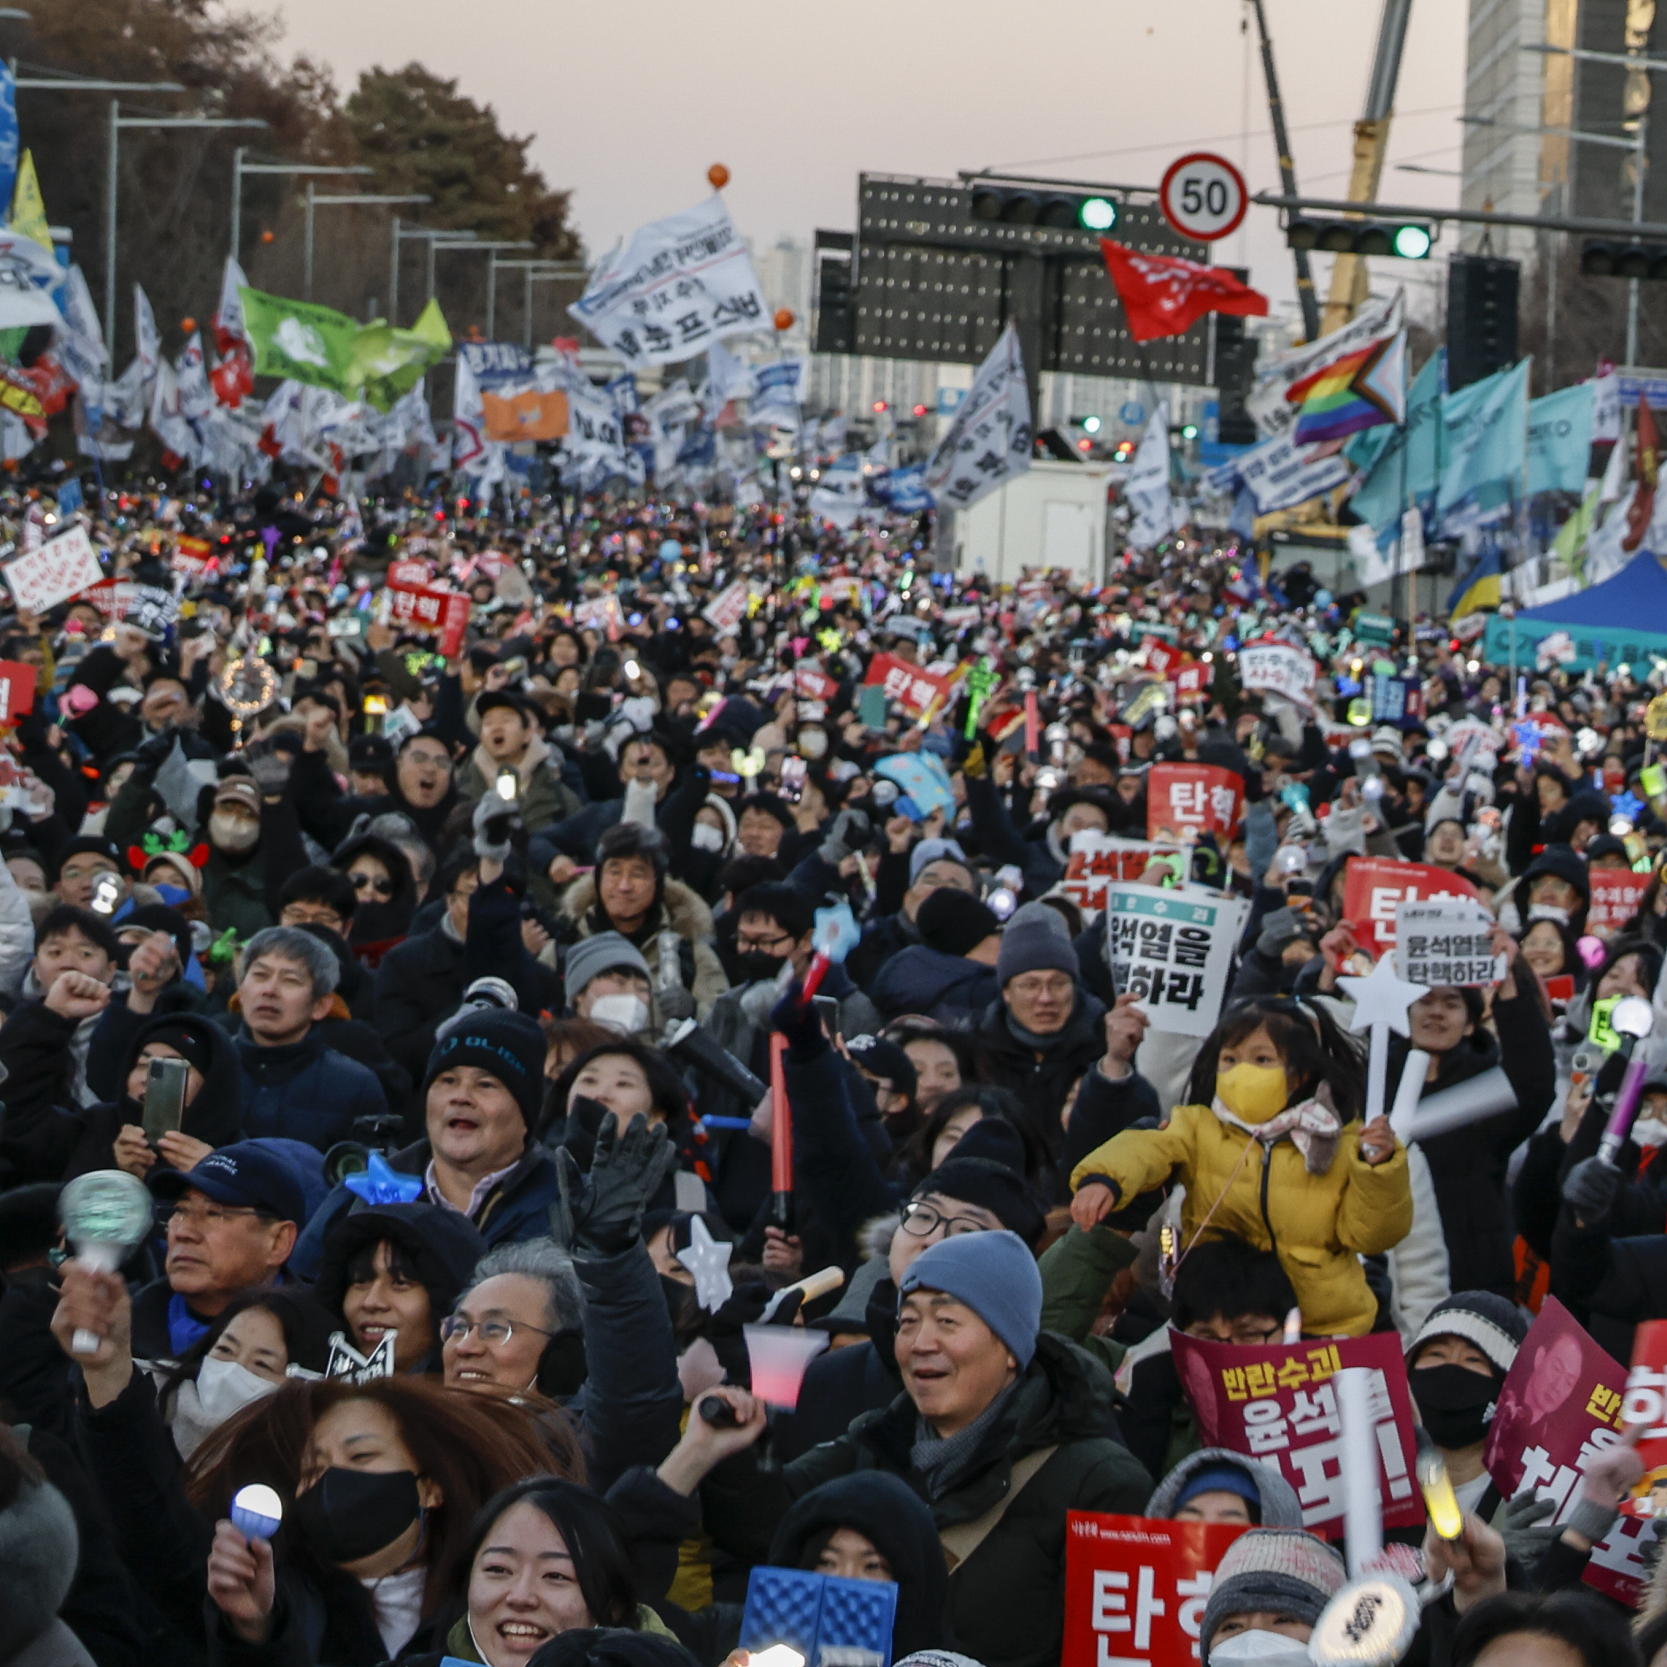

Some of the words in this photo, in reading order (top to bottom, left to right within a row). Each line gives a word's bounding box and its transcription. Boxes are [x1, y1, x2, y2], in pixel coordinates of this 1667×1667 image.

[1181, 178, 1228, 216] 50
[885, 665, 937, 706] 탄핵
[1168, 783, 1235, 836] 탄핵
[1407, 935, 1494, 958] 윤석열을
[1407, 961, 1497, 986] 탄핵하라
[1221, 1345, 1343, 1402] 반란수괴
